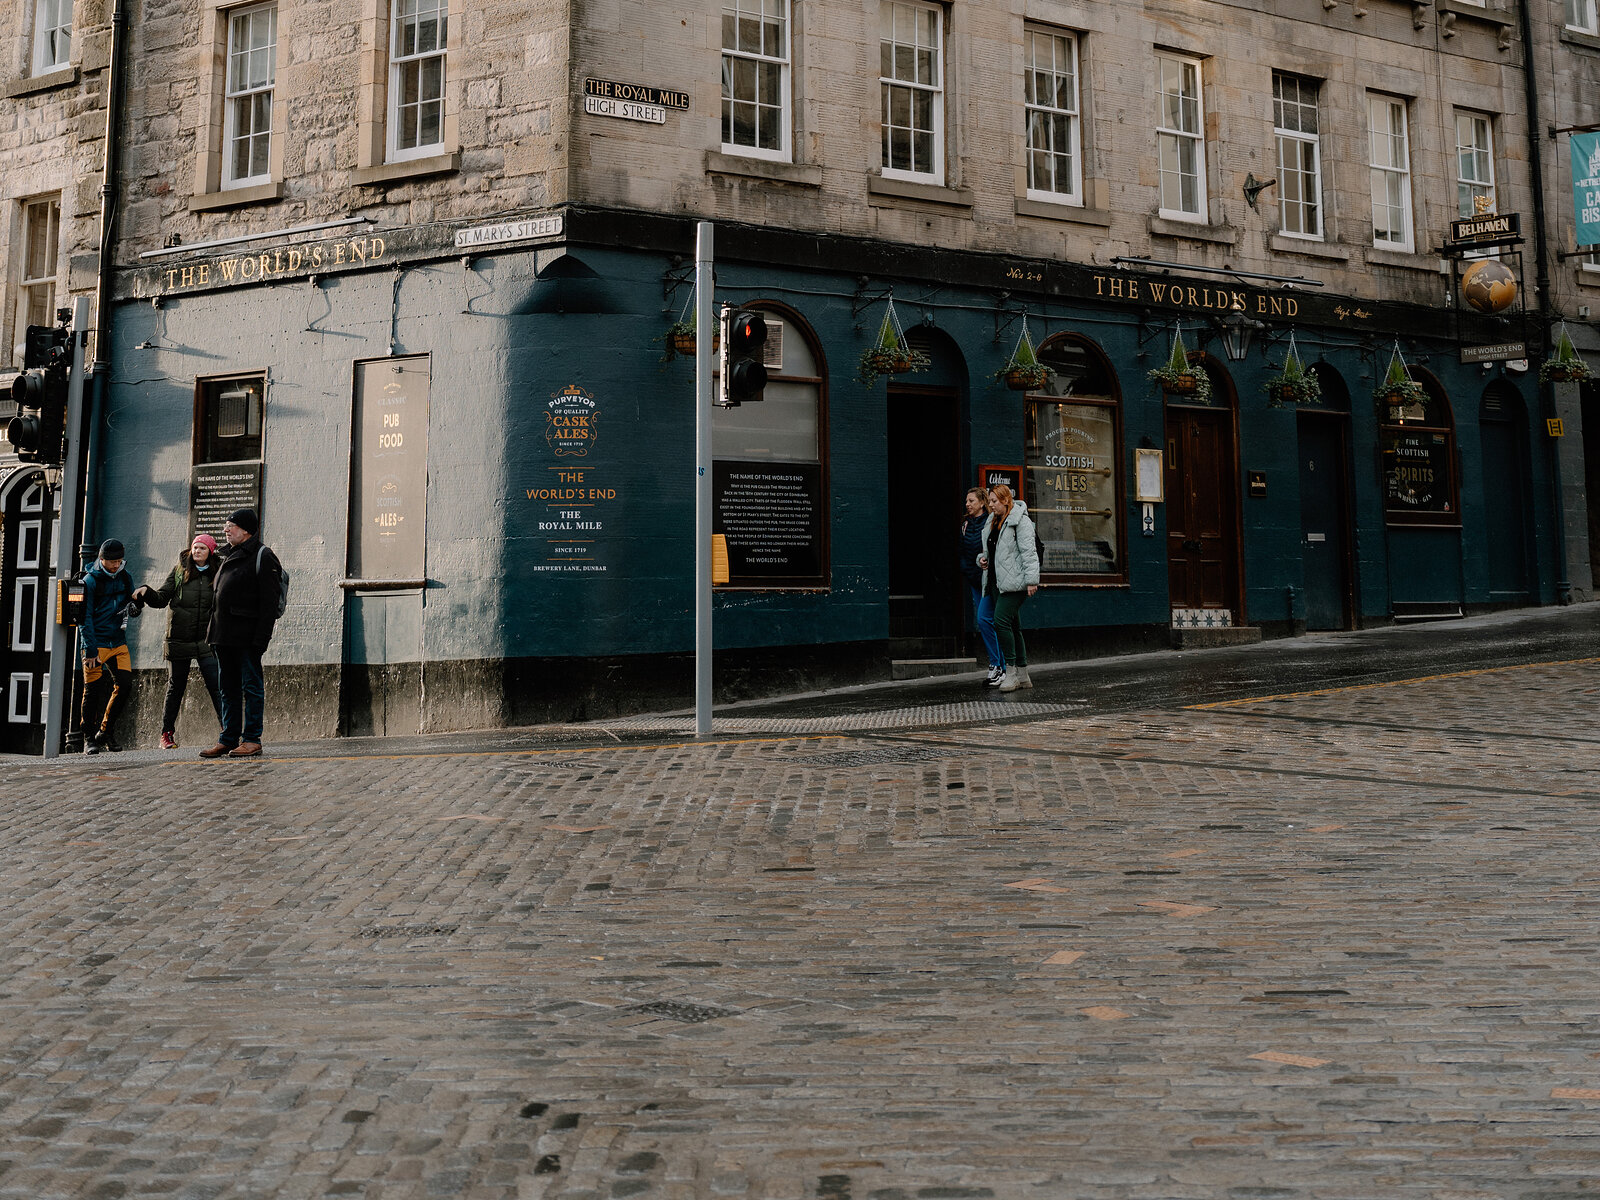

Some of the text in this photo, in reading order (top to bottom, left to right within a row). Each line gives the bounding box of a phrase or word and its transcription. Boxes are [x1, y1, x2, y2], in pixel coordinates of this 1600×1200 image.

[588, 80, 688, 107] THE ROYAL MILE
[588, 99, 664, 121] HIGH STREET
[457, 231, 471, 245] ST.
[517, 218, 559, 237] STREET
[1458, 217, 1509, 238] BELHAVEN
[166, 238, 385, 290] THE WORLD'S END
[1093, 275, 1298, 316] THE WORLD'S END
[1477, 345, 1508, 354] WORLD'S
[1508, 344, 1523, 352] END
[548, 395, 596, 408] PURVEYOR
[383, 413, 400, 428] PUB
[553, 416, 589, 427] CASK
[379, 432, 403, 449] FOOD
[553, 428, 589, 439] ALES
[1045, 427, 1095, 443] PROUDLY POURING
[1405, 438, 1419, 446] FINE
[1396, 448, 1429, 457] SCOTTISH
[1045, 455, 1095, 468] SCOTTISH
[1309, 460, 1315, 471] 6
[558, 472, 584, 483] THE
[1394, 466, 1434, 483] SPIRITS
[1055, 474, 1087, 492] ALES
[526, 488, 616, 500] WORLD'S END
[380, 512, 397, 527] ALES
[560, 511, 581, 519] THE
[538, 521, 602, 530] ROYAL MILE
